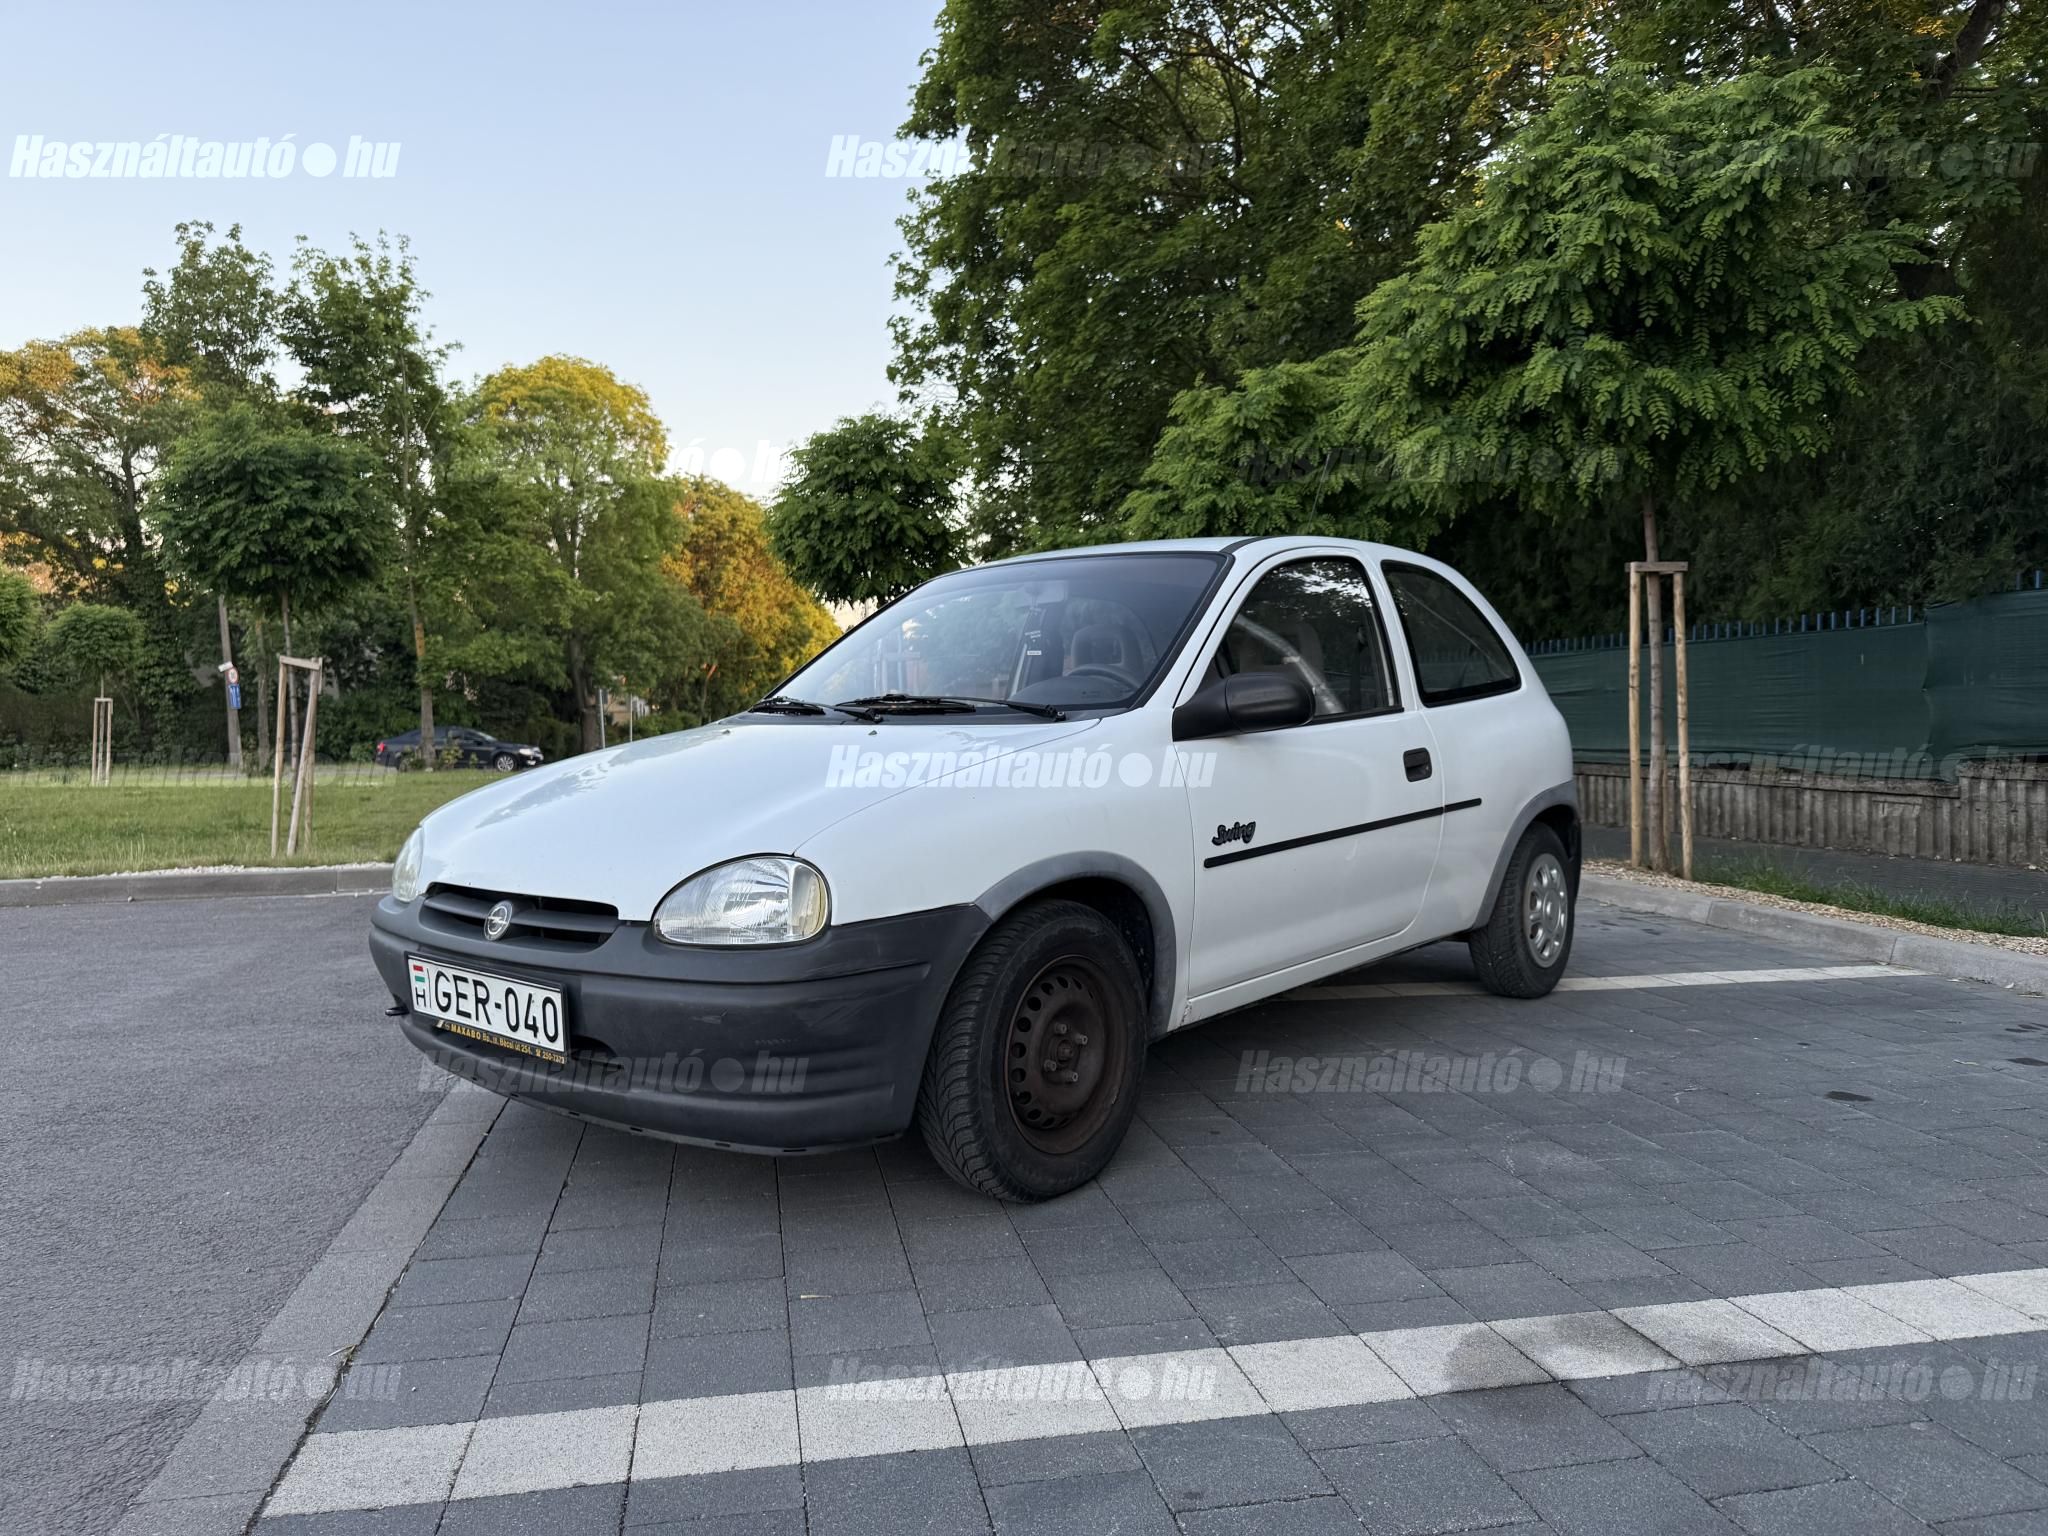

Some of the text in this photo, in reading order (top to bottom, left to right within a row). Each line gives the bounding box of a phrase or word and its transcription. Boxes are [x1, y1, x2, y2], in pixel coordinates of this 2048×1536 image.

[1212, 821, 1256, 846] Swing
[415, 970, 559, 1043] H GER-040
